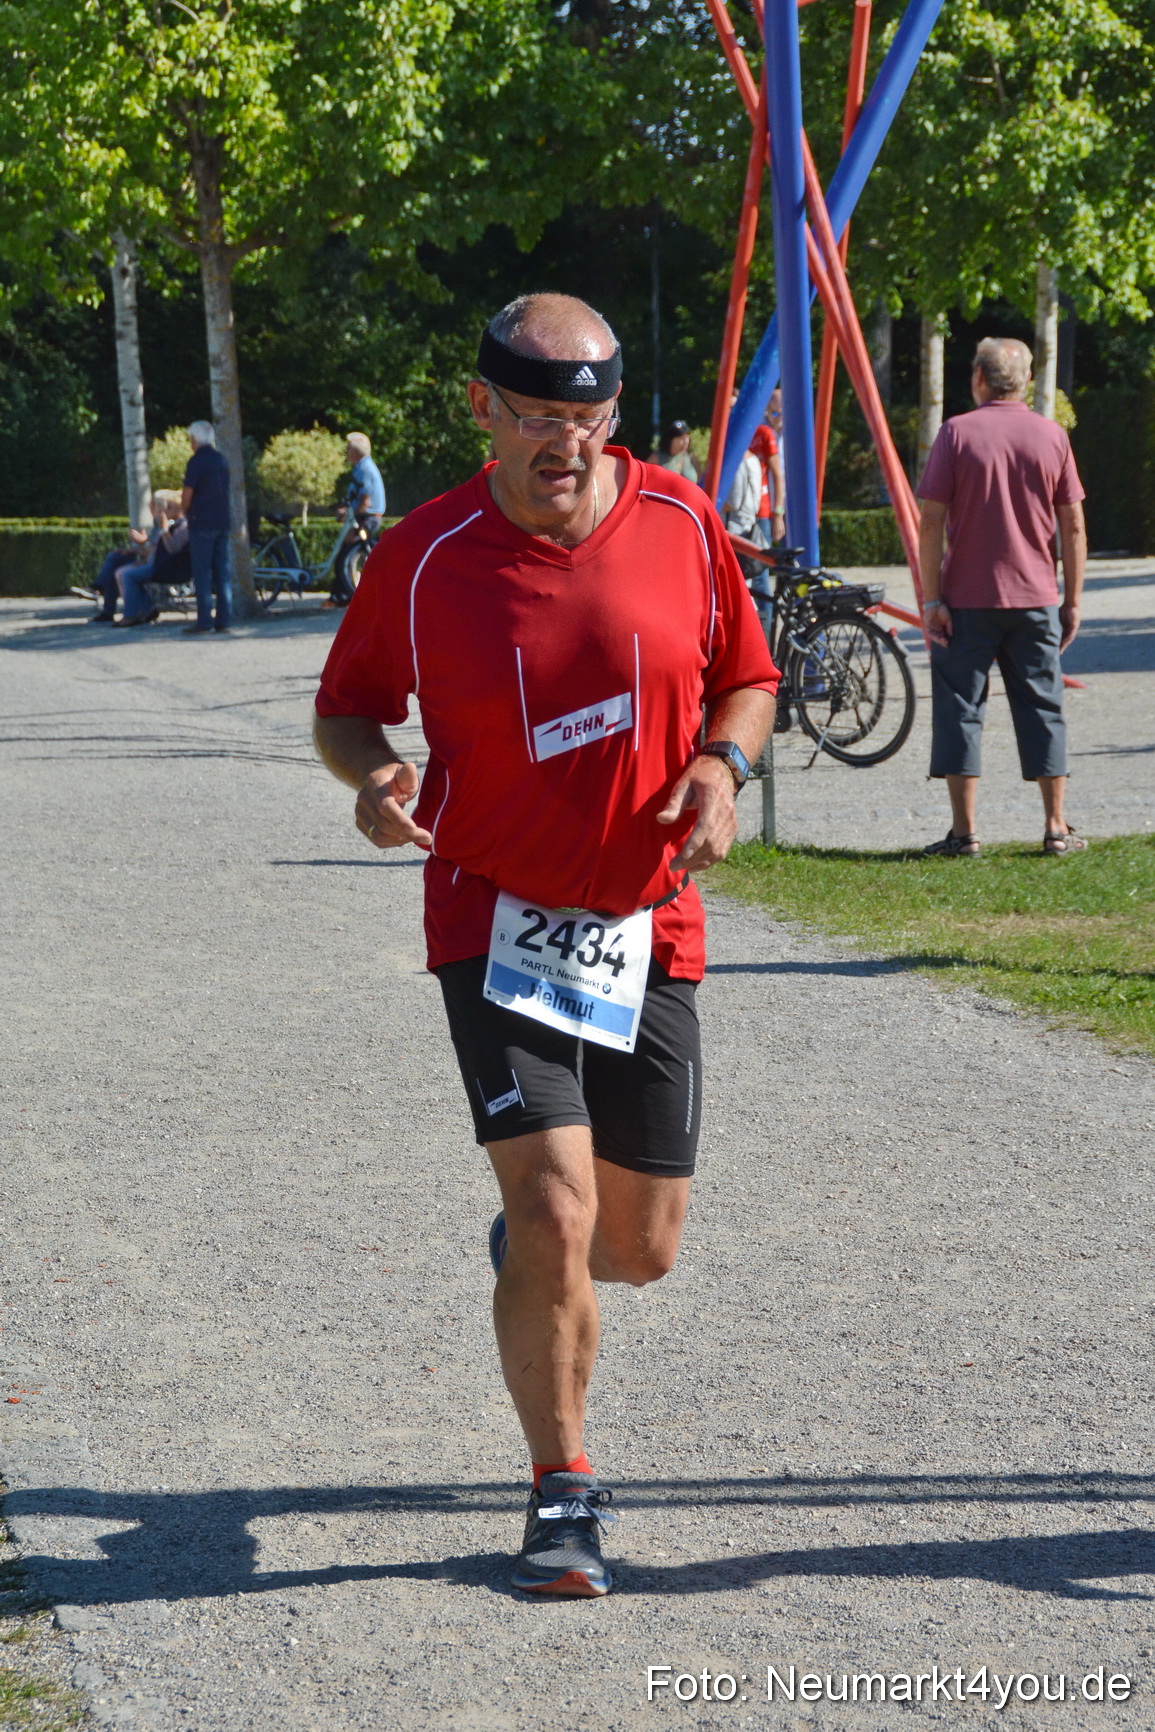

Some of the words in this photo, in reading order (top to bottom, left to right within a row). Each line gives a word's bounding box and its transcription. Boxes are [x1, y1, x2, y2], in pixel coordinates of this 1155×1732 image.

[570, 378, 597, 386] adidas
[562, 712, 605, 742] DEHN
[514, 908, 626, 978] 2434
[521, 957, 555, 976] PARTL
[556, 968, 600, 990] Neumarkt
[529, 982, 595, 1021] Helmut
